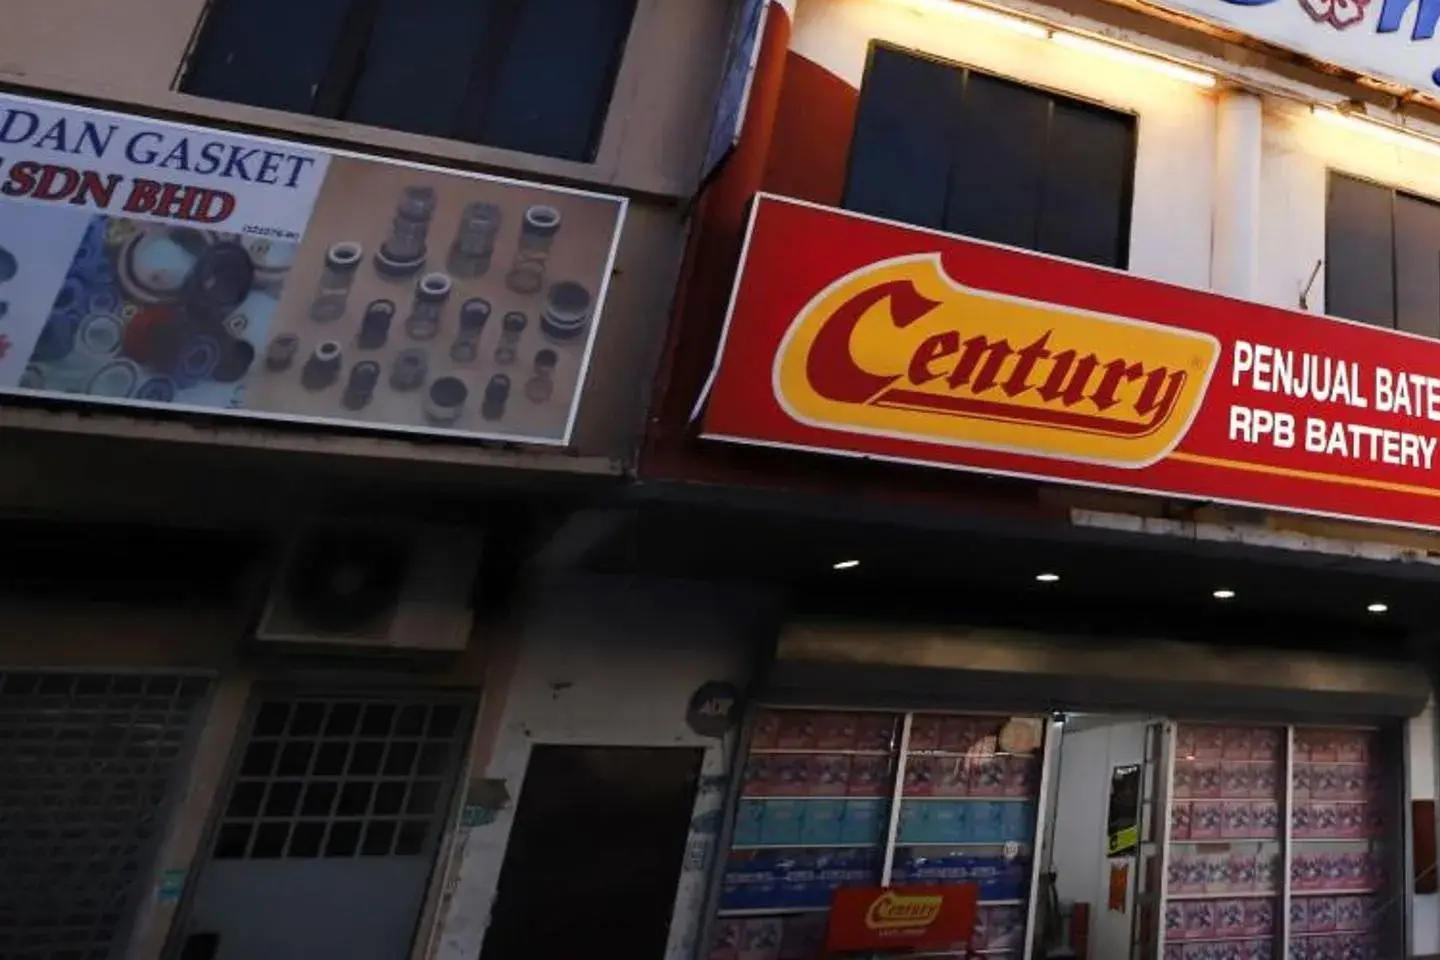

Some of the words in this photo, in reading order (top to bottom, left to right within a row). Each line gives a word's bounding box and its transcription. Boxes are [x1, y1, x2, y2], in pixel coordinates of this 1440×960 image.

[0, 108, 119, 158] DAN
[124, 131, 315, 189] GASKET
[2, 159, 124, 209] SDN
[121, 177, 237, 225] BHD
[805, 278, 1184, 439] Century
[1231, 342, 1367, 408] PENJUAL
[1229, 407, 1296, 449] RPB
[1304, 417, 1437, 474] BATTERY
